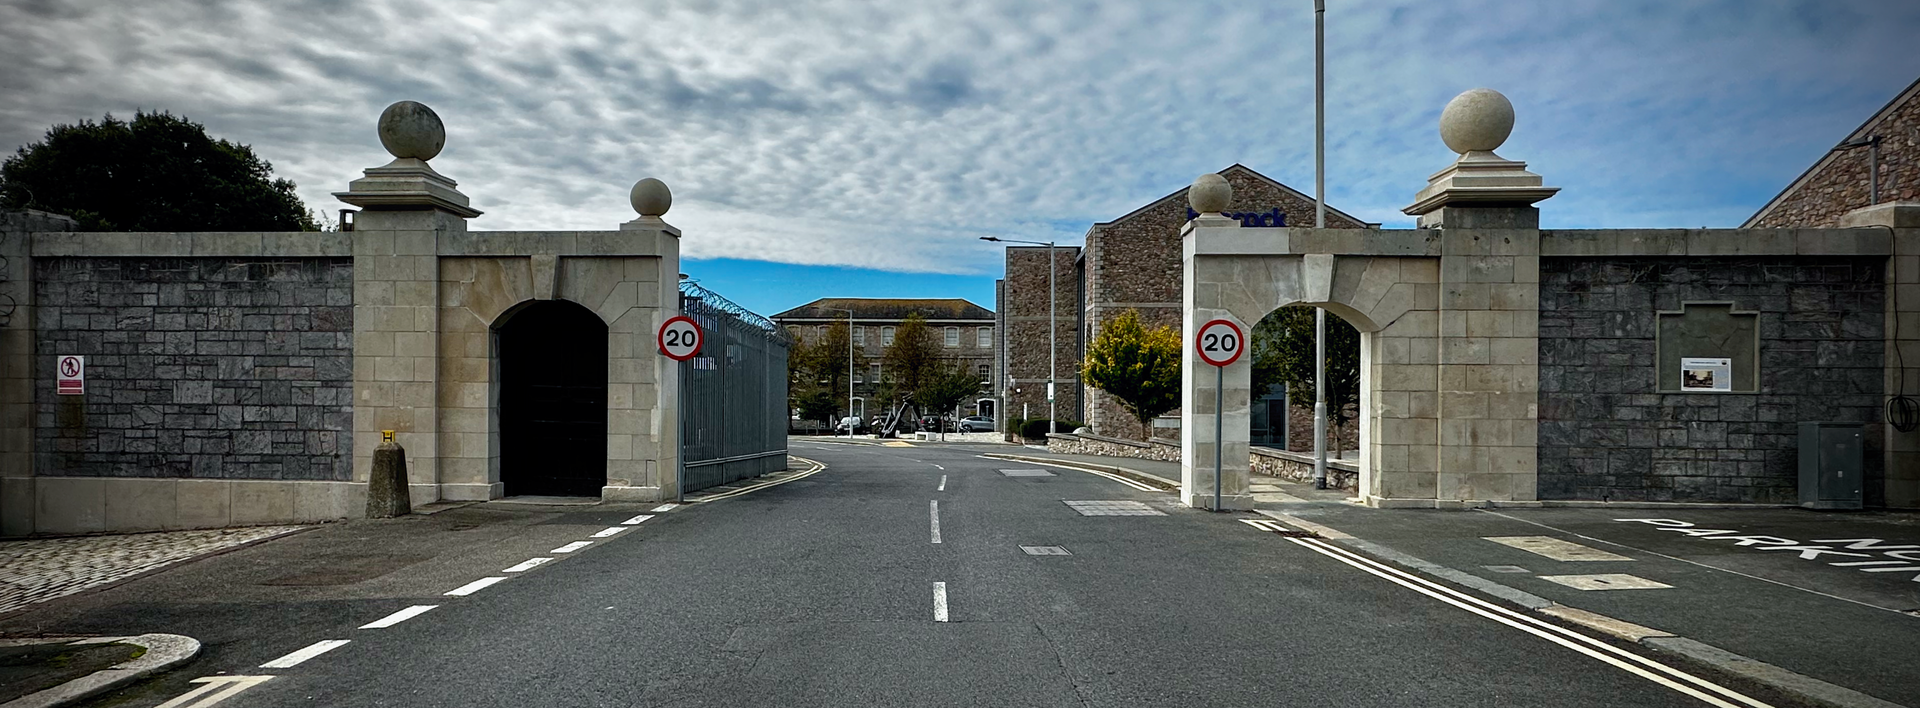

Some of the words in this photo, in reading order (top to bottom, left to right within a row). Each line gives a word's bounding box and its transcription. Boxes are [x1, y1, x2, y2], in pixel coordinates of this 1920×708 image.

[666, 329, 696, 347] 20
[1204, 333, 1236, 352] 20
[382, 431, 393, 442] H
